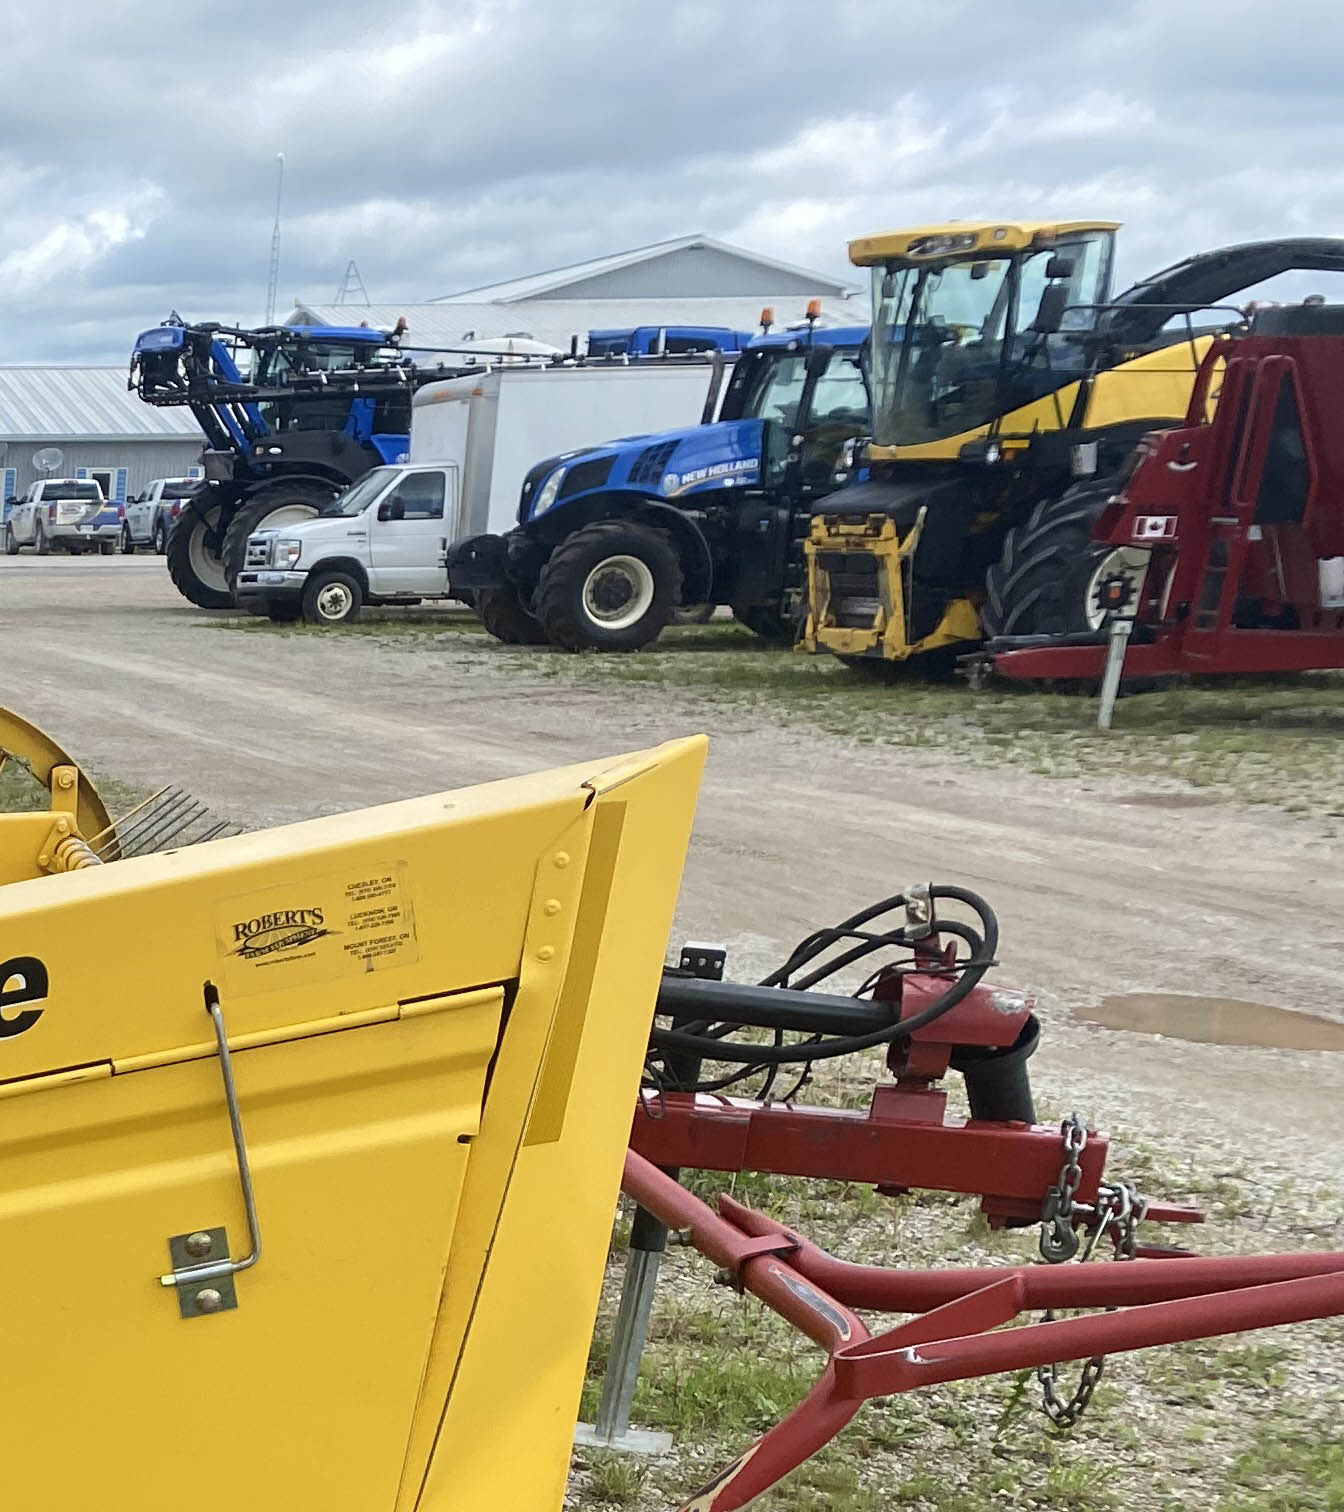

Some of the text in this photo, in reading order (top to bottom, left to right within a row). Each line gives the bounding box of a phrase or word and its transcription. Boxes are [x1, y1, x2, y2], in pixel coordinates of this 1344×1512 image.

[681, 468, 707, 484] NEW
[708, 458, 759, 477] HOLLAND
[232, 907, 324, 942] ROBERT'S
